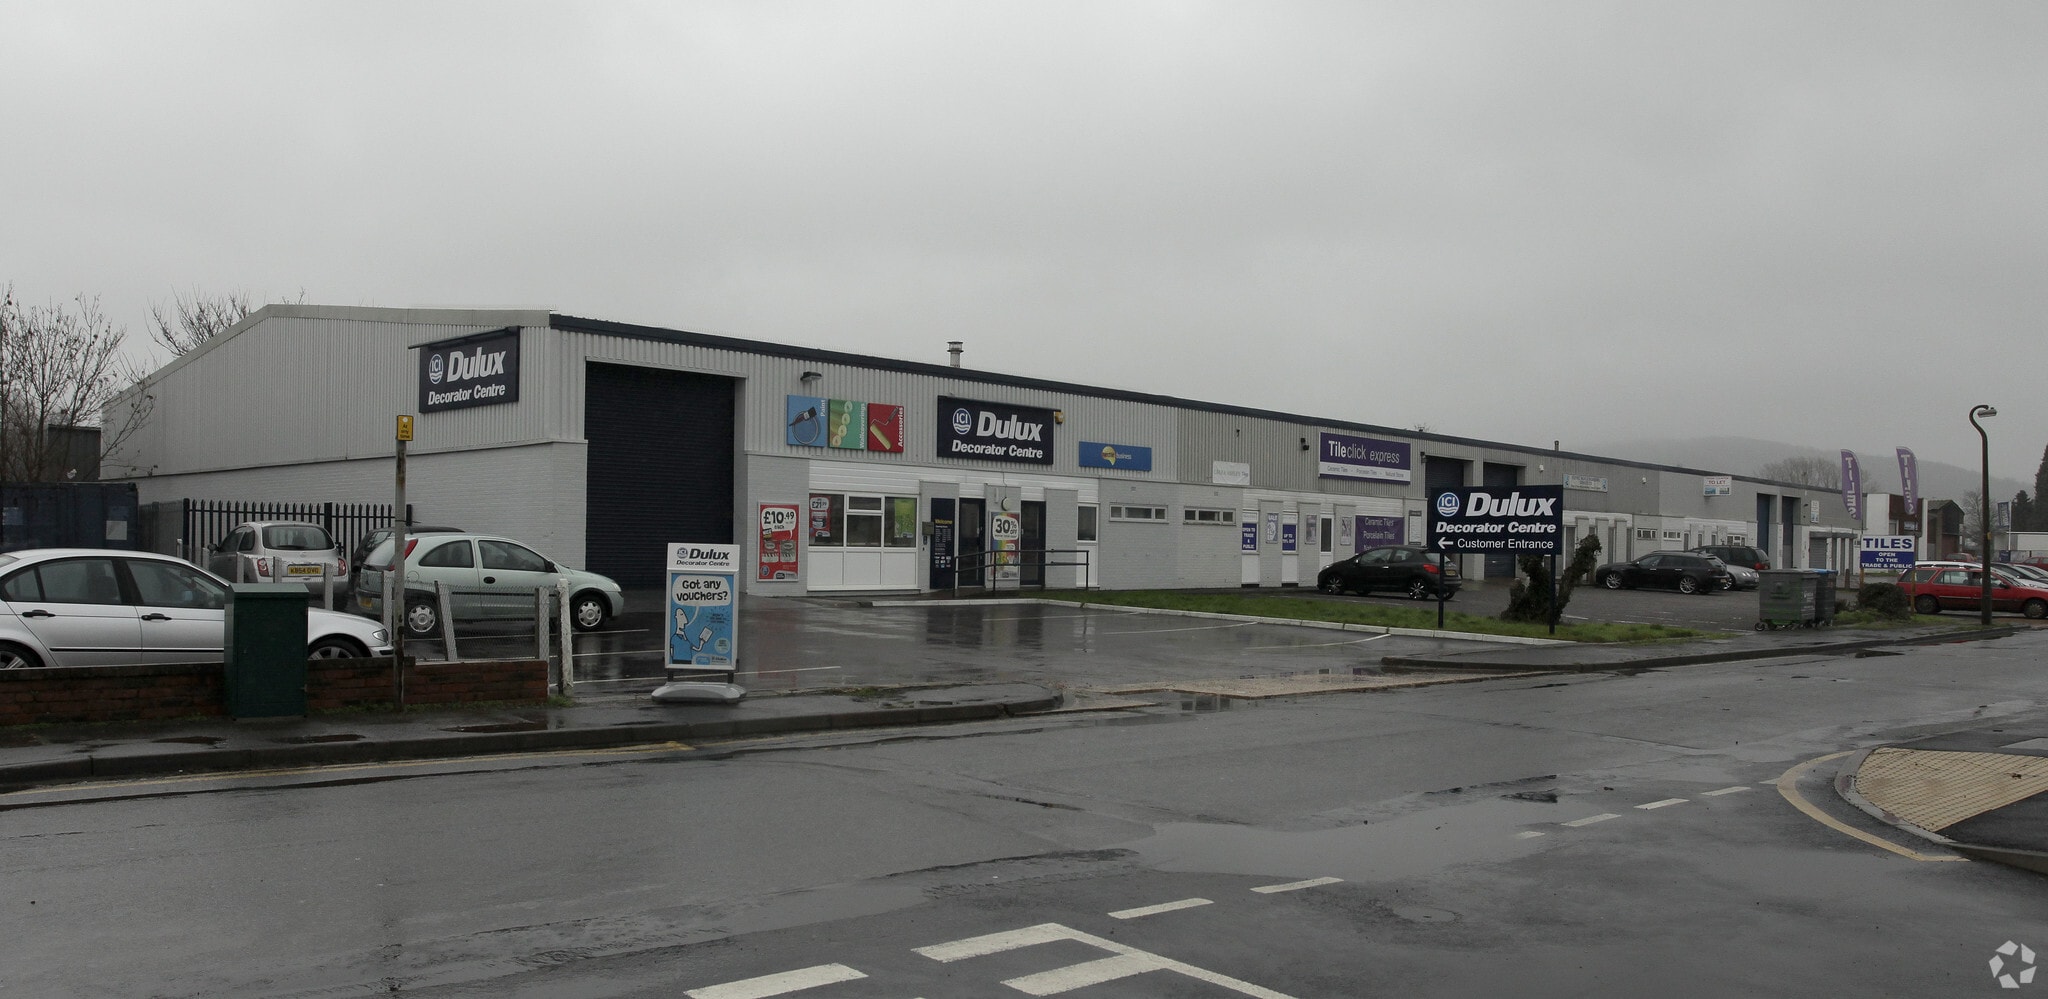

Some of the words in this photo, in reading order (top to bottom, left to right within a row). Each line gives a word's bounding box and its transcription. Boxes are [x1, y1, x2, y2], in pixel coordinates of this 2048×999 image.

[431, 360, 441, 372] ICI
[447, 347, 506, 382] Dulux
[428, 389, 472, 405] Decorator
[474, 384, 505, 399] Centre
[956, 413, 968, 424] ICI
[976, 410, 1043, 442] Dulux
[951, 439, 1007, 456] Decorator
[1008, 444, 1043, 459] Centre
[1369, 450, 1400, 465] express
[1441, 496, 1456, 507] ICI
[1465, 491, 1557, 517] Dulux
[763, 511, 794, 524] £10.49
[1364, 518, 1382, 526] Ceramic
[1435, 521, 1505, 533] Decorator
[1507, 521, 1557, 533] Centre
[1363, 531, 1384, 540] Porcelain
[1457, 538, 1506, 549] Customer
[1508, 538, 1554, 549] Entrance
[1863, 538, 1913, 549] TILES
[689, 548, 730, 560] Dulux
[682, 579, 701, 589] Got
[703, 580, 721, 589] any
